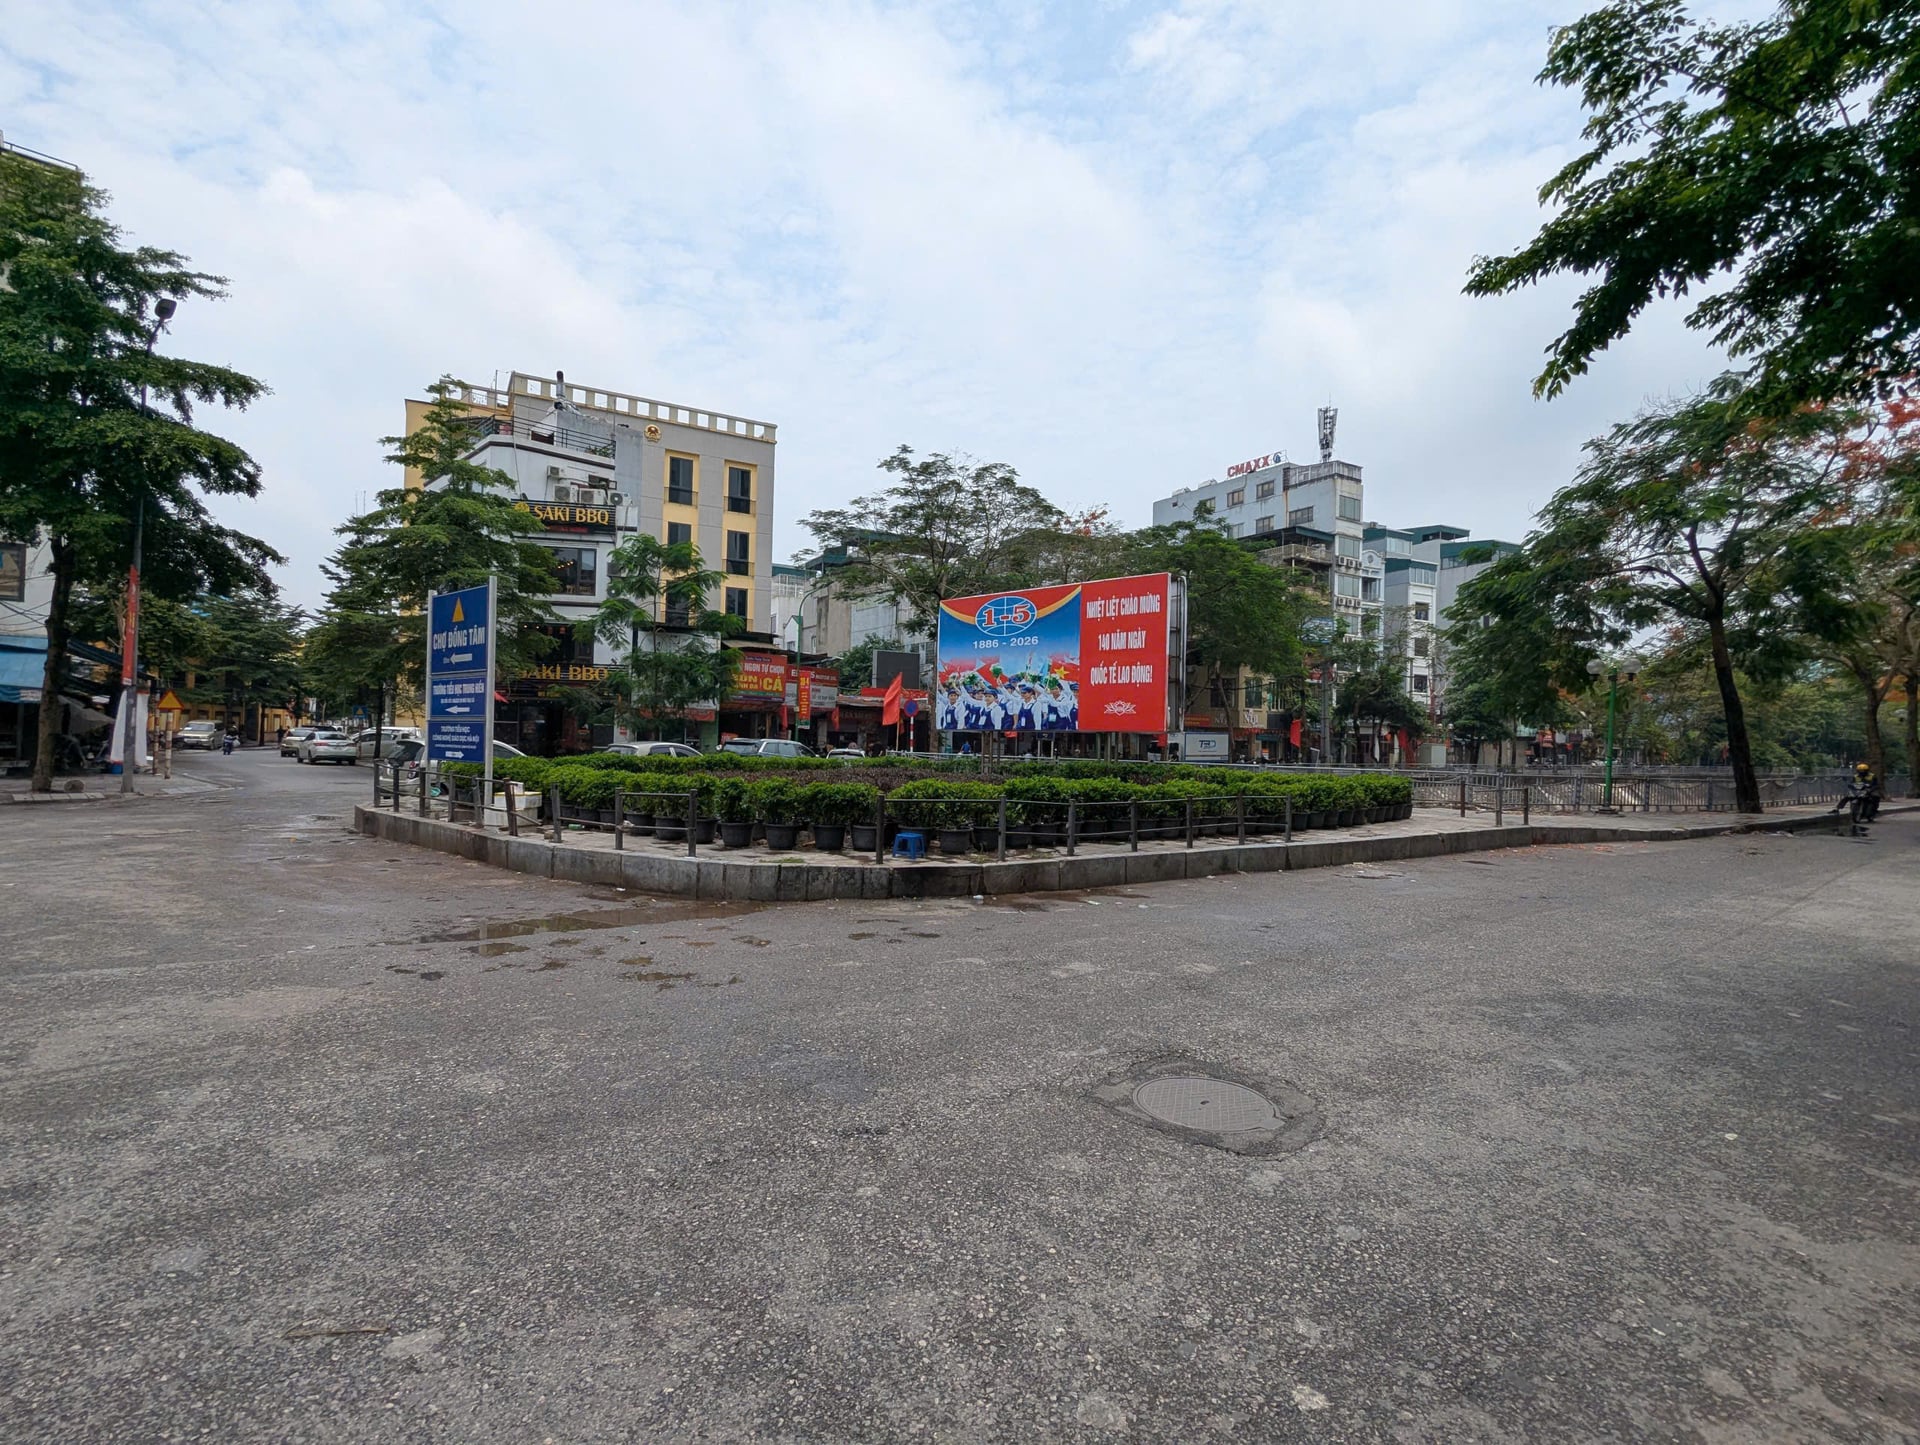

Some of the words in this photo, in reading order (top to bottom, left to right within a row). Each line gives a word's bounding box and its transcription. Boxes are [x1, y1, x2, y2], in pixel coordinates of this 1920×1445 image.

[1227, 455, 1271, 478] CMAXX
[534, 505, 570, 522] SAKI
[575, 508, 609, 526] BBQ
[982, 603, 1032, 627] 1-5
[1086, 596, 1105, 622] NHIỆT
[1105, 594, 1120, 621] LIỆT
[1120, 593, 1138, 616] CHÀO
[1139, 591, 1160, 614] MỪNG
[433, 630, 447, 652] CHỢ
[468, 624, 486, 646] TÂM
[972, 639, 999, 650] 1886
[1010, 636, 1039, 647] 2026
[1098, 633, 1110, 651] 140
[1111, 628, 1127, 651] NĂM
[1127, 626, 1147, 649] NGÀY
[762, 675, 783, 692] CÁ
[1090, 660, 1108, 686] QUỐC
[1108, 660, 1118, 684] TẾ
[1118, 665, 1131, 684] LAO
[1131, 661, 1153, 687] ĐỘNG!
